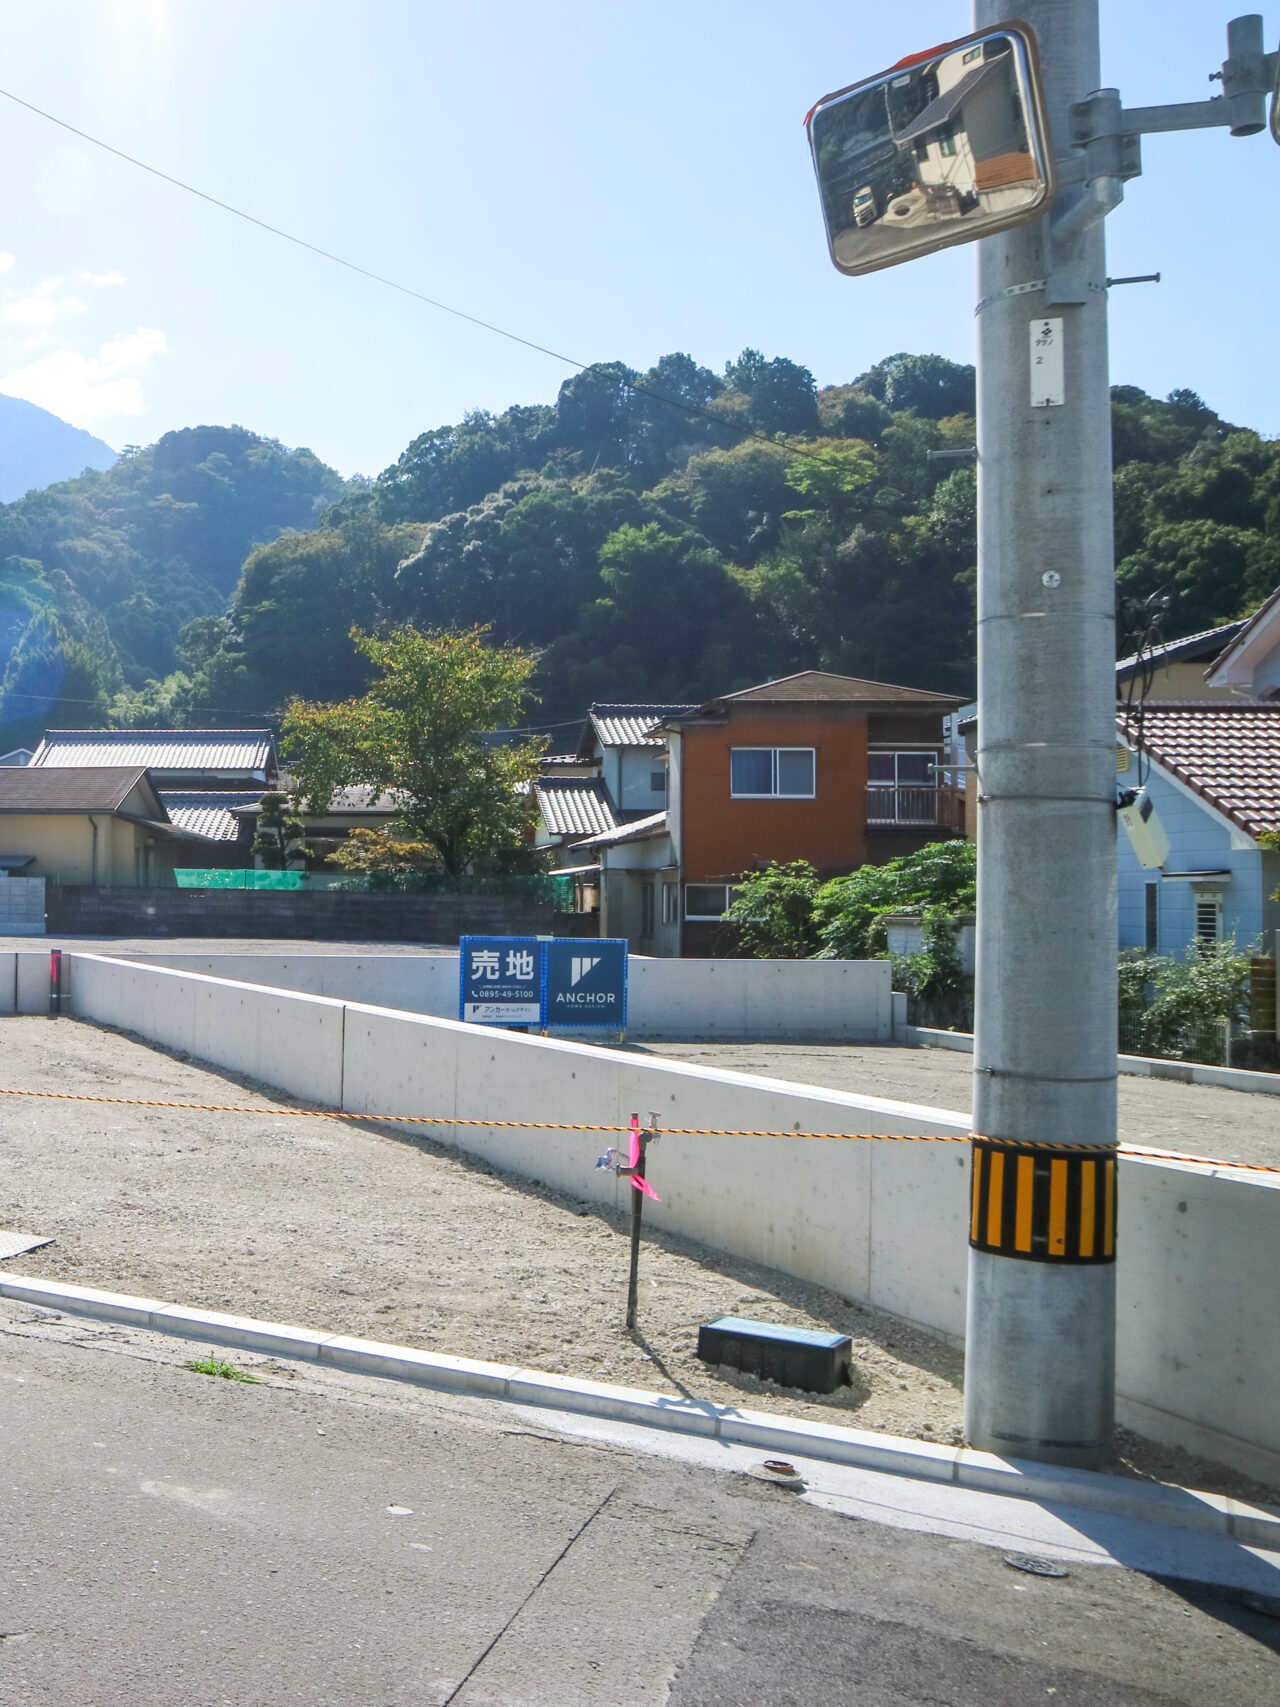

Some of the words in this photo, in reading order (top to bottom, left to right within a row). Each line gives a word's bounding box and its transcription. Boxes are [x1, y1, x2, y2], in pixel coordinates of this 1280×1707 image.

[1036, 356, 1044, 364] 2
[471, 949, 534, 980] 売地
[479, 990, 534, 998] 0895-49-5100
[556, 992, 615, 1003] ANCHOR
